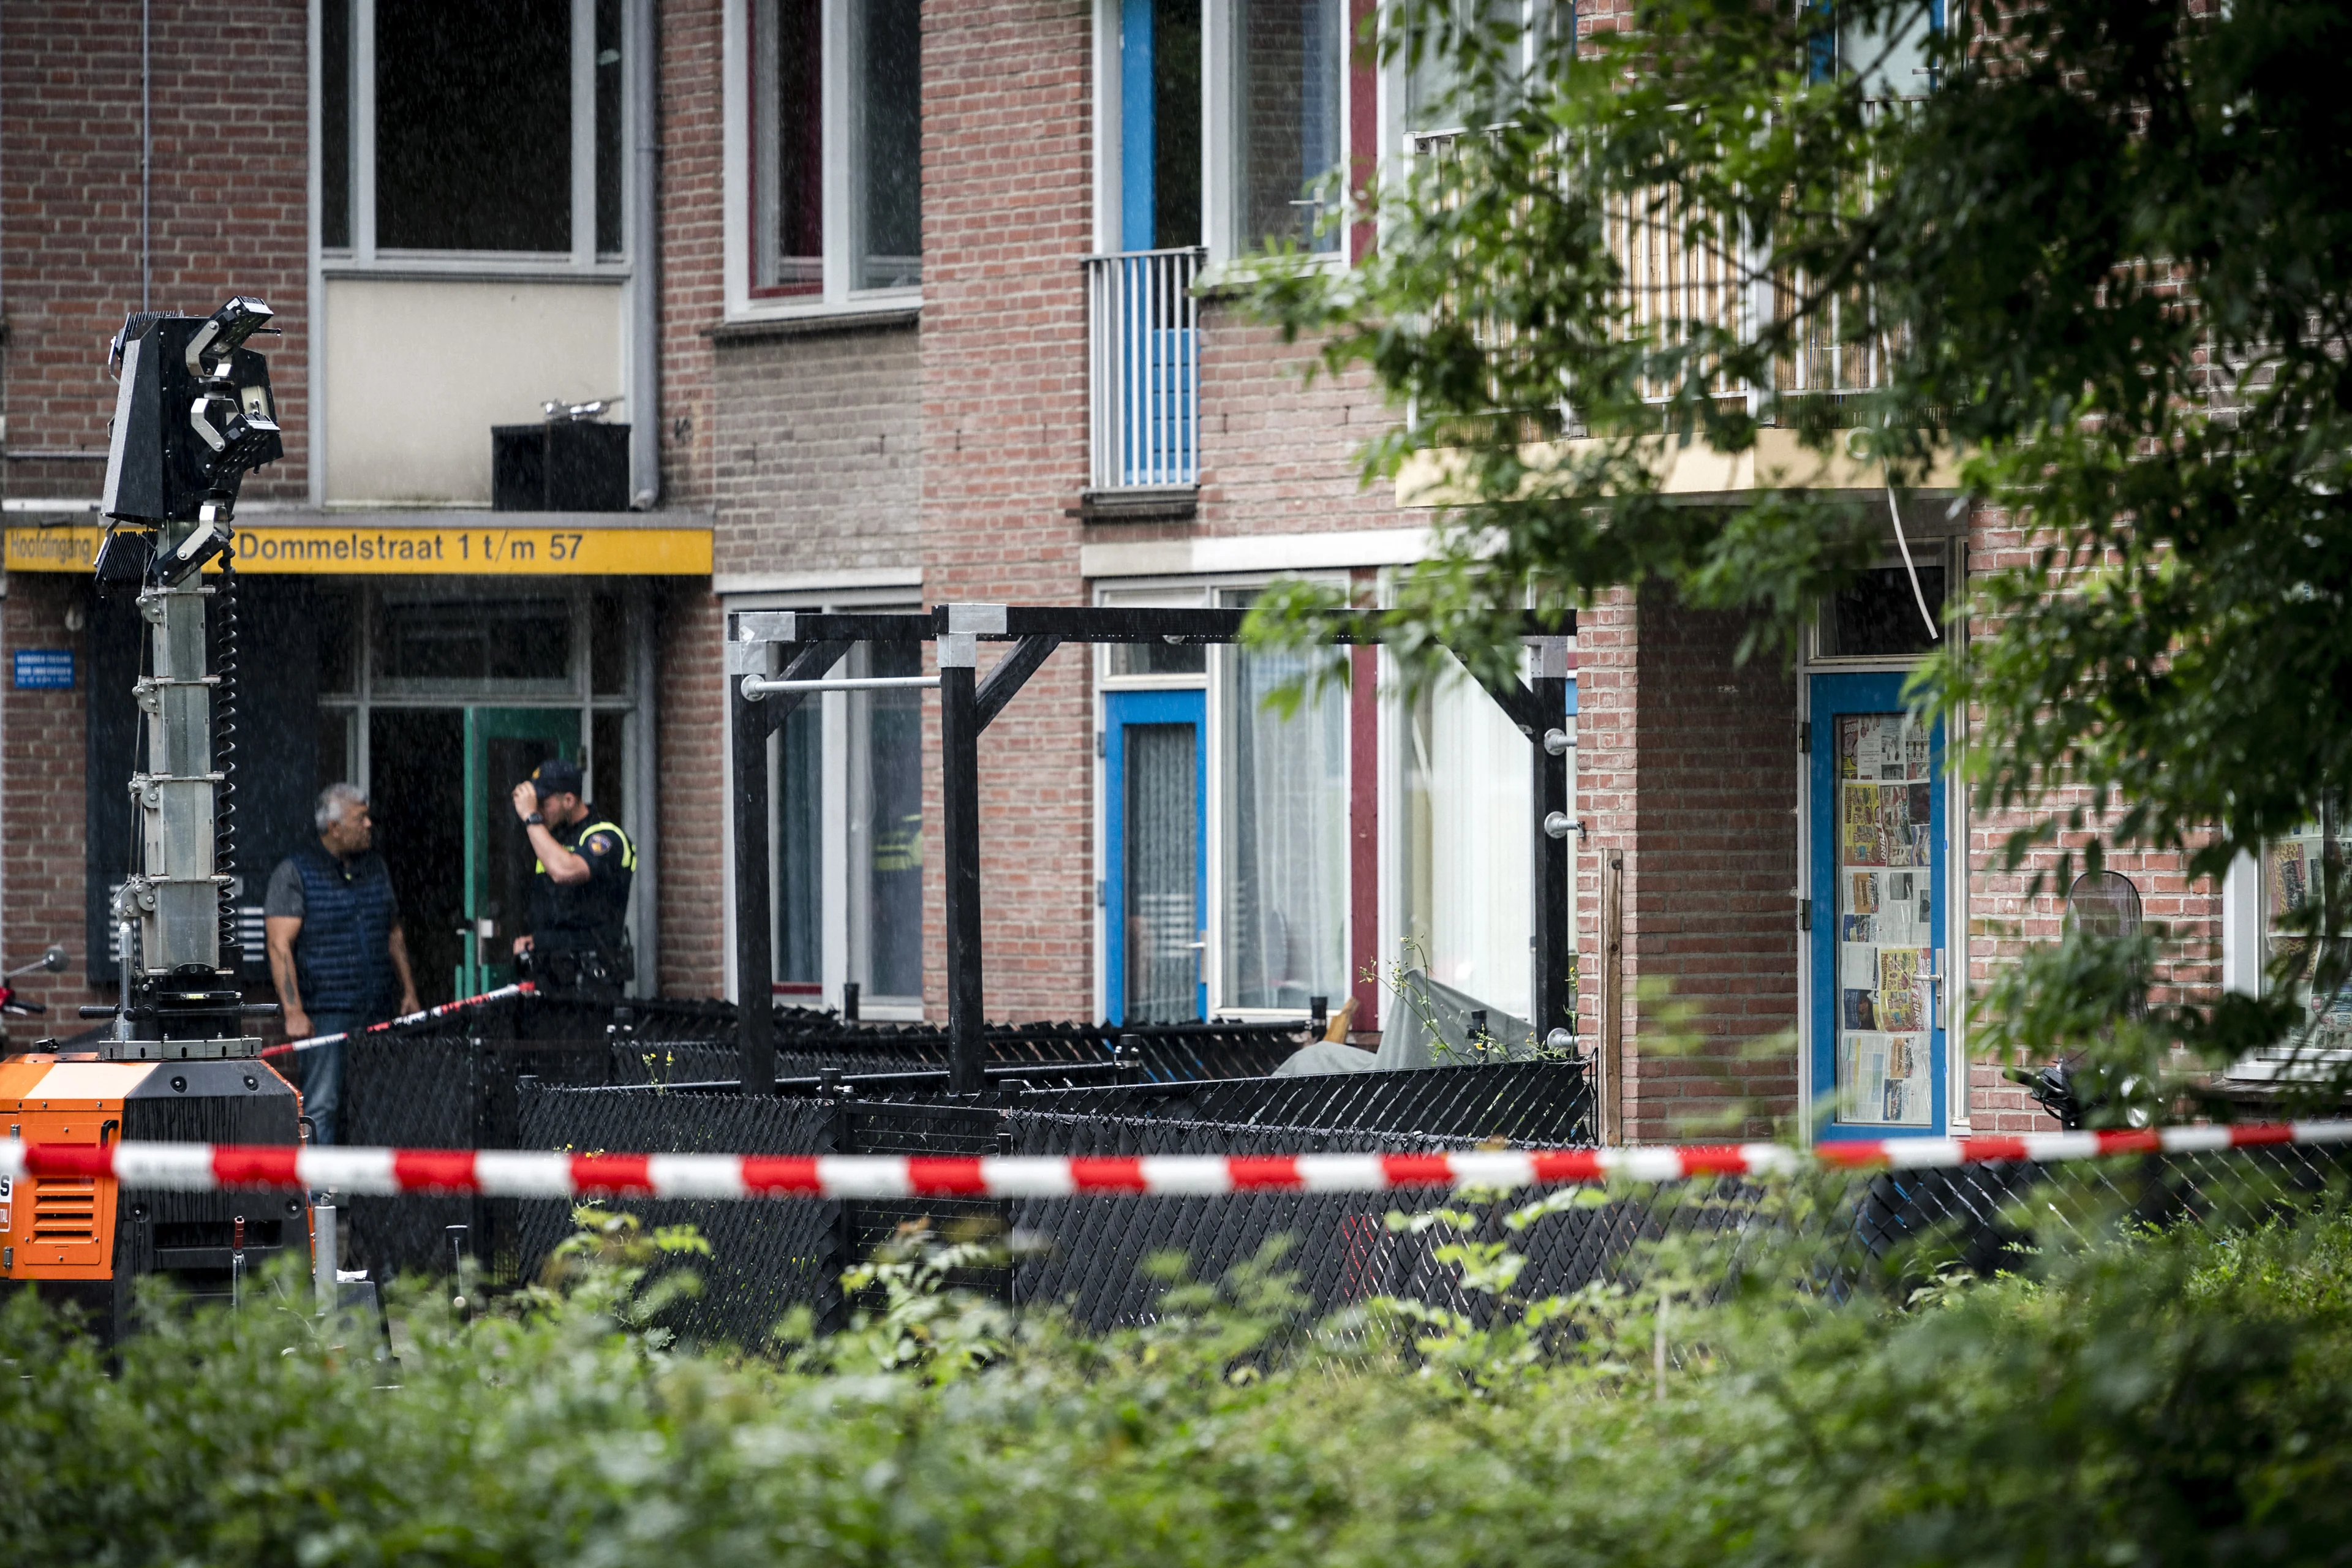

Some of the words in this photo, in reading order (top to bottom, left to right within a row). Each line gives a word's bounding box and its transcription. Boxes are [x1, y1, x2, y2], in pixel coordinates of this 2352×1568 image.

[10, 530, 91, 564] Hoofdingang
[239, 532, 443, 560] Dommelstraat
[458, 532, 469, 560] 1
[483, 529, 535, 563] t/m
[550, 533, 583, 560] 57
[1878, 831, 1887, 860] EURO
[1912, 997, 1922, 1025] EURO
